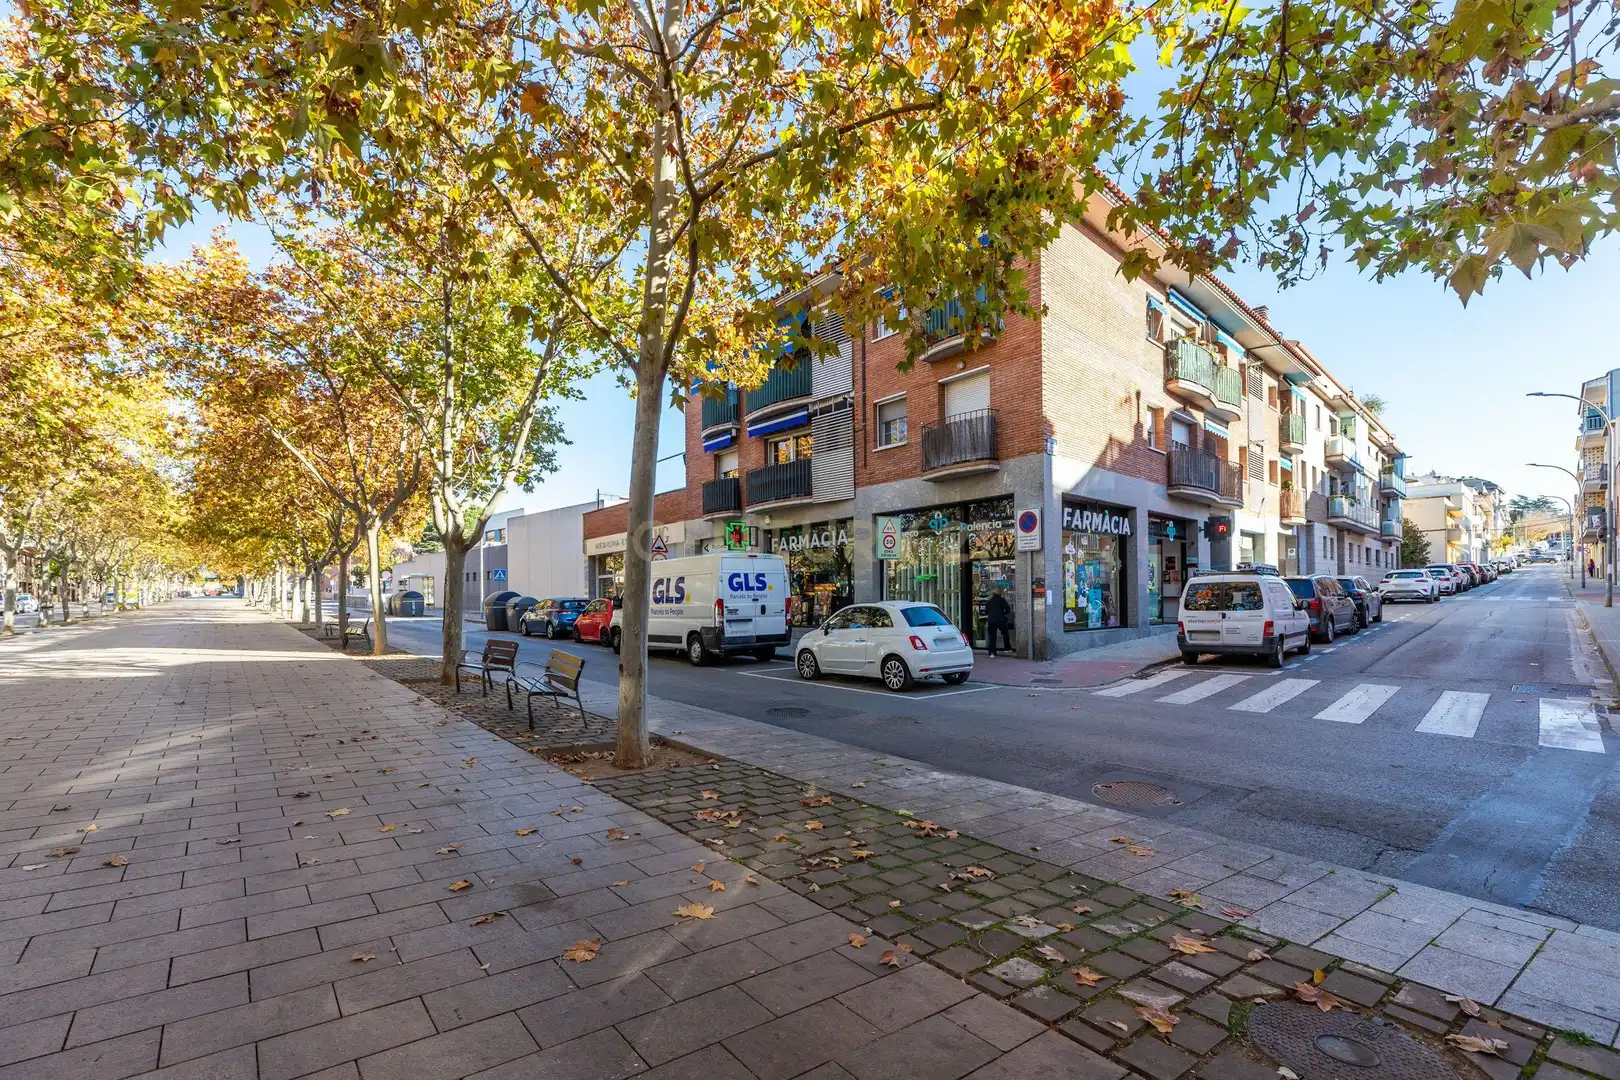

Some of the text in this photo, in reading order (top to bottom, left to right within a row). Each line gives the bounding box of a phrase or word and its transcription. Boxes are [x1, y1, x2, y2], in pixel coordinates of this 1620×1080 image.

[960, 519, 1003, 533] Palencia
[1062, 507, 1131, 536] FARMÀCIA
[771, 529, 849, 552] FARMÀCIA
[885, 538, 894, 546] 30
[650, 608, 665, 616] Parcels
[669, 608, 684, 616] People
